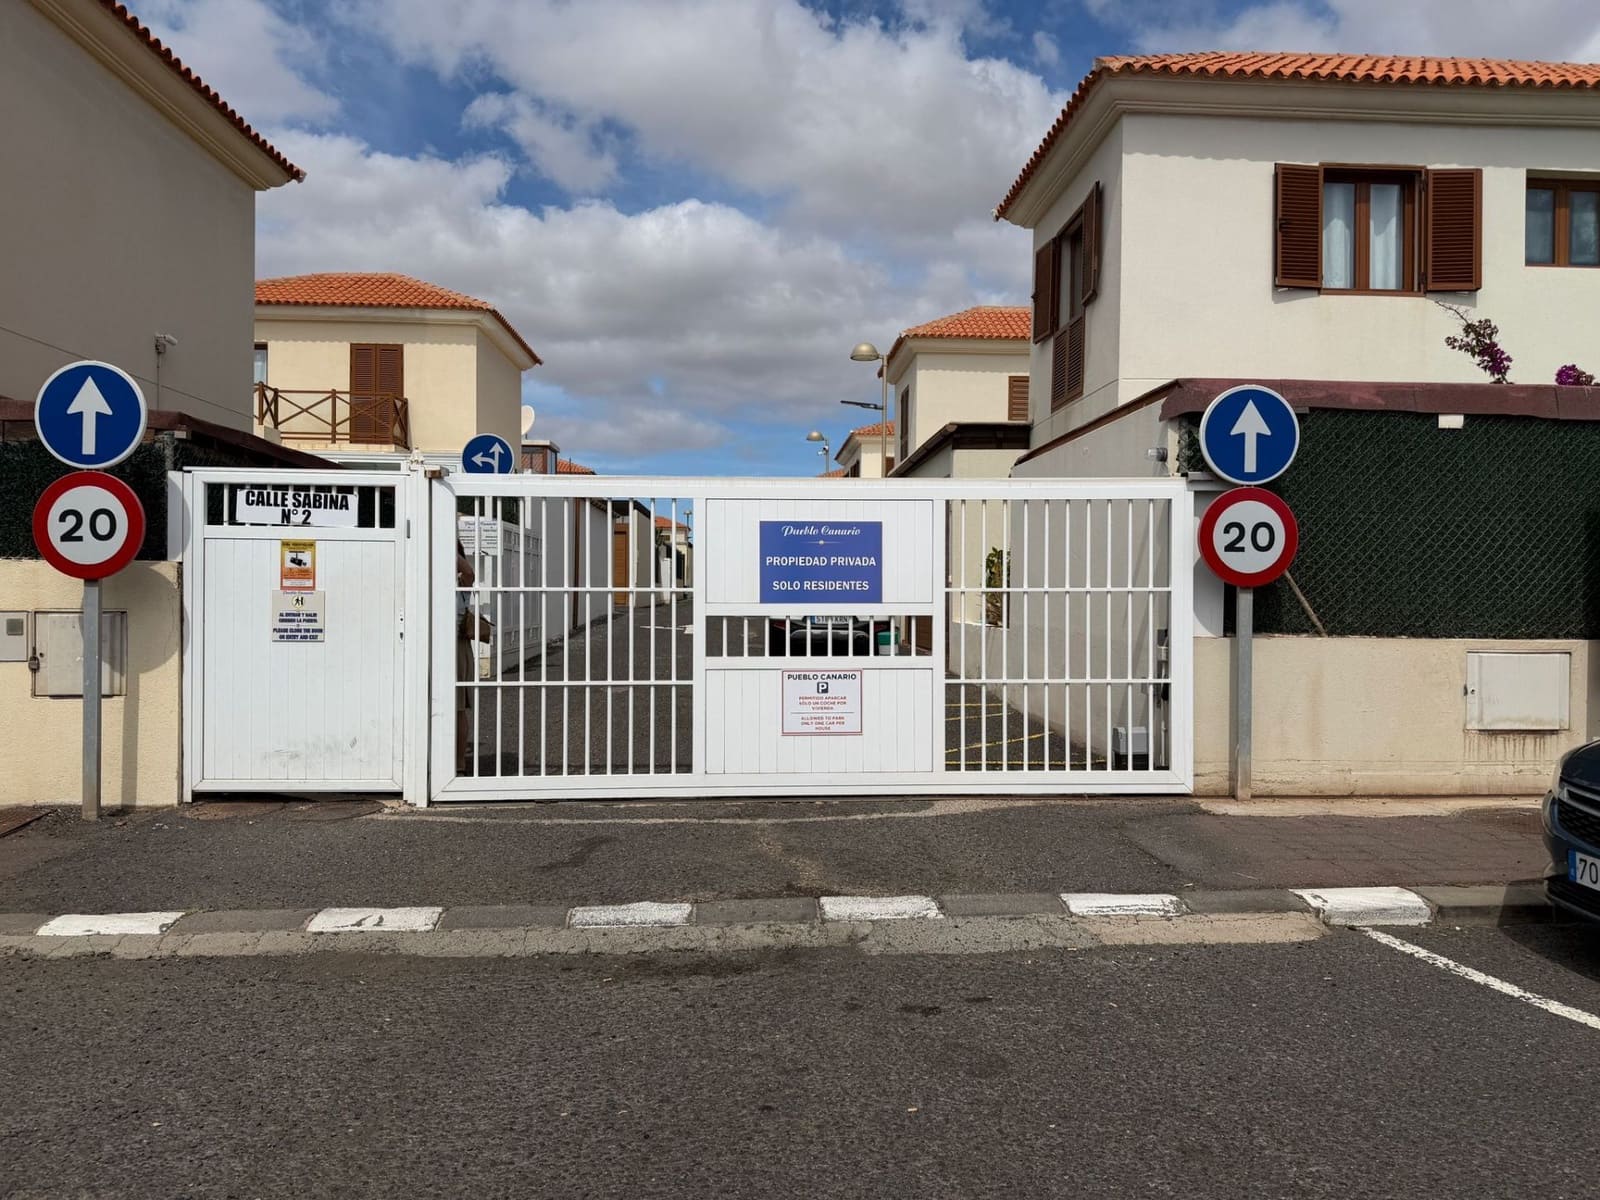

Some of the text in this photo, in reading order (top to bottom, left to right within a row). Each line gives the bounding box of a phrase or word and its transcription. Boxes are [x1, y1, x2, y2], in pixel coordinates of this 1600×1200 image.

[246, 490, 350, 510] CALLE SABINA
[302, 510, 312, 525] 2
[58, 508, 117, 543] 20
[781, 525, 861, 537] Pueblo Canario
[1223, 521, 1276, 553] 20
[766, 556, 876, 566] PROPIEDAD PRIVADA
[772, 580, 870, 591] SOLO RESIDENTES
[787, 673, 857, 681] PUEBLO CANARIO
[1579, 857, 1599, 885] 70
